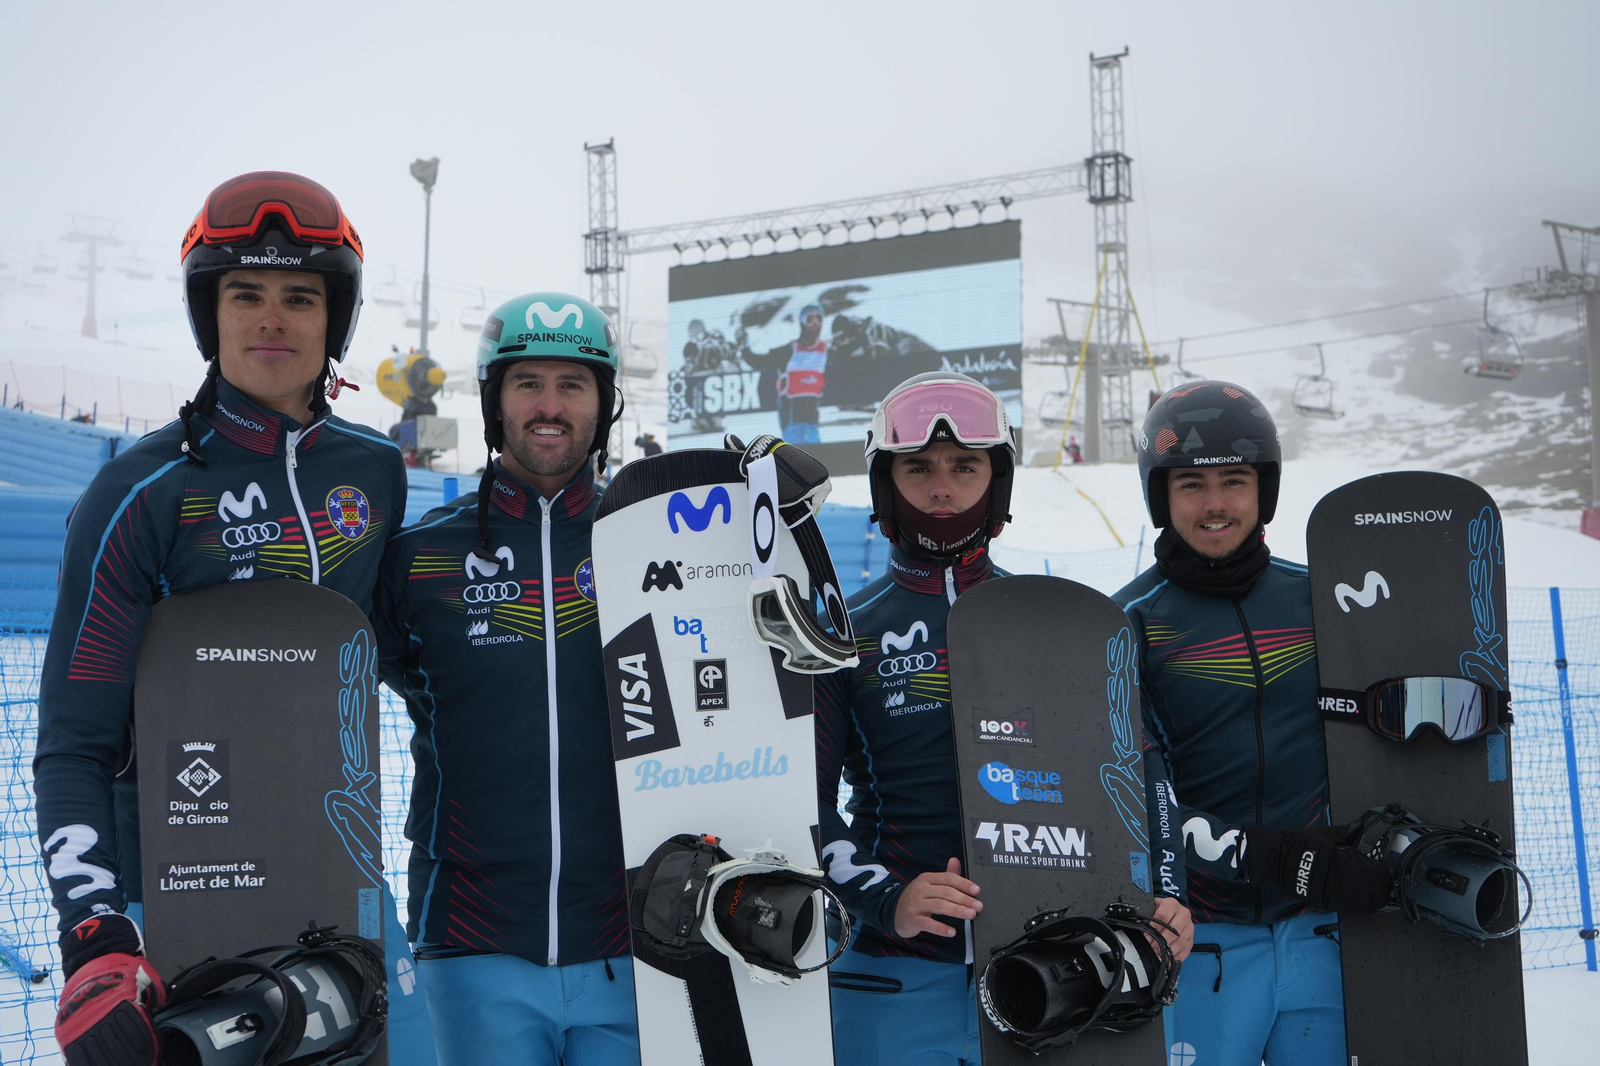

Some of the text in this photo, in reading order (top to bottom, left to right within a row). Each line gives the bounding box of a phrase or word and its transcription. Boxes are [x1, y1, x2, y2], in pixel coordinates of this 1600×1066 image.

[240, 256, 302, 265] SPAINSNOW
[517, 333, 592, 346] SPAINSNOW
[704, 371, 761, 413] SBX
[215, 401, 265, 432] SPAINSNOW
[1194, 456, 1242, 465] SPAINSNOW
[1354, 509, 1452, 526] SPAINSNOW
[229, 550, 256, 562] Audi
[687, 562, 754, 580] aramon
[472, 634, 523, 646] IBERDROLA
[196, 648, 317, 662] SPAINSNOW
[882, 678, 906, 688] Audi
[618, 653, 655, 741] VISA
[1317, 697, 1359, 713] HRED.
[1562, 682, 1570, 727] LISKI
[890, 702, 942, 717] IBERDROLA
[635, 746, 788, 792] Barebells
[987, 763, 1061, 787] basque
[1011, 780, 1063, 803] team
[1155, 782, 1170, 839] IBERDROLA
[168, 814, 229, 824] de Girona
[1003, 824, 1085, 857] RAW
[169, 862, 256, 876] Ajuntament de
[994, 854, 1086, 868] ORGANIC SPORT DRINK
[1160, 849, 1180, 896] Audi
[160, 875, 265, 891] Lloret de Mar
